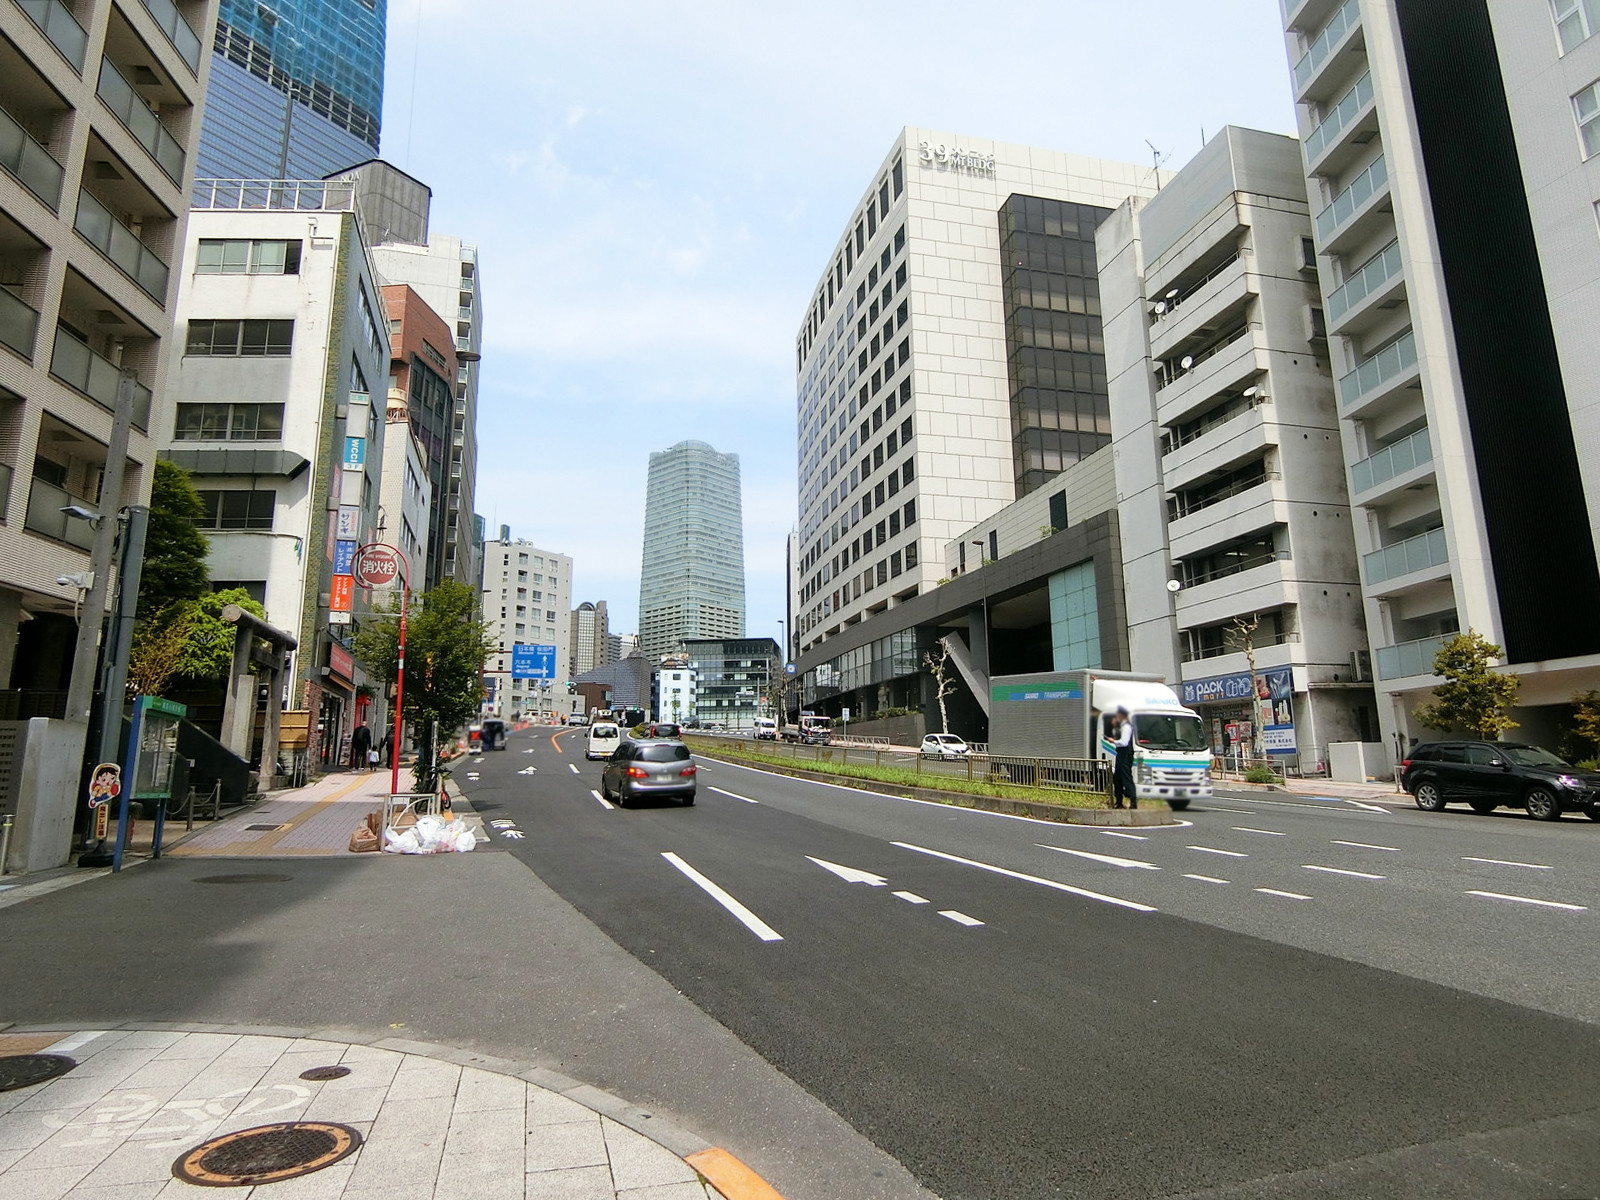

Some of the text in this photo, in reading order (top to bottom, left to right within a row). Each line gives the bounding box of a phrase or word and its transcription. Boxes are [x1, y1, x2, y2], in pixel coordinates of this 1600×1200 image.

[919, 141, 950, 163] 39
[967, 158, 995, 171] BLDG
[349, 439, 360, 463] WCCI
[362, 560, 395, 575] 消火栓
[1196, 680, 1224, 702] PACK
[1203, 692, 1225, 701] mart
[1144, 697, 1179, 706] SANKO
